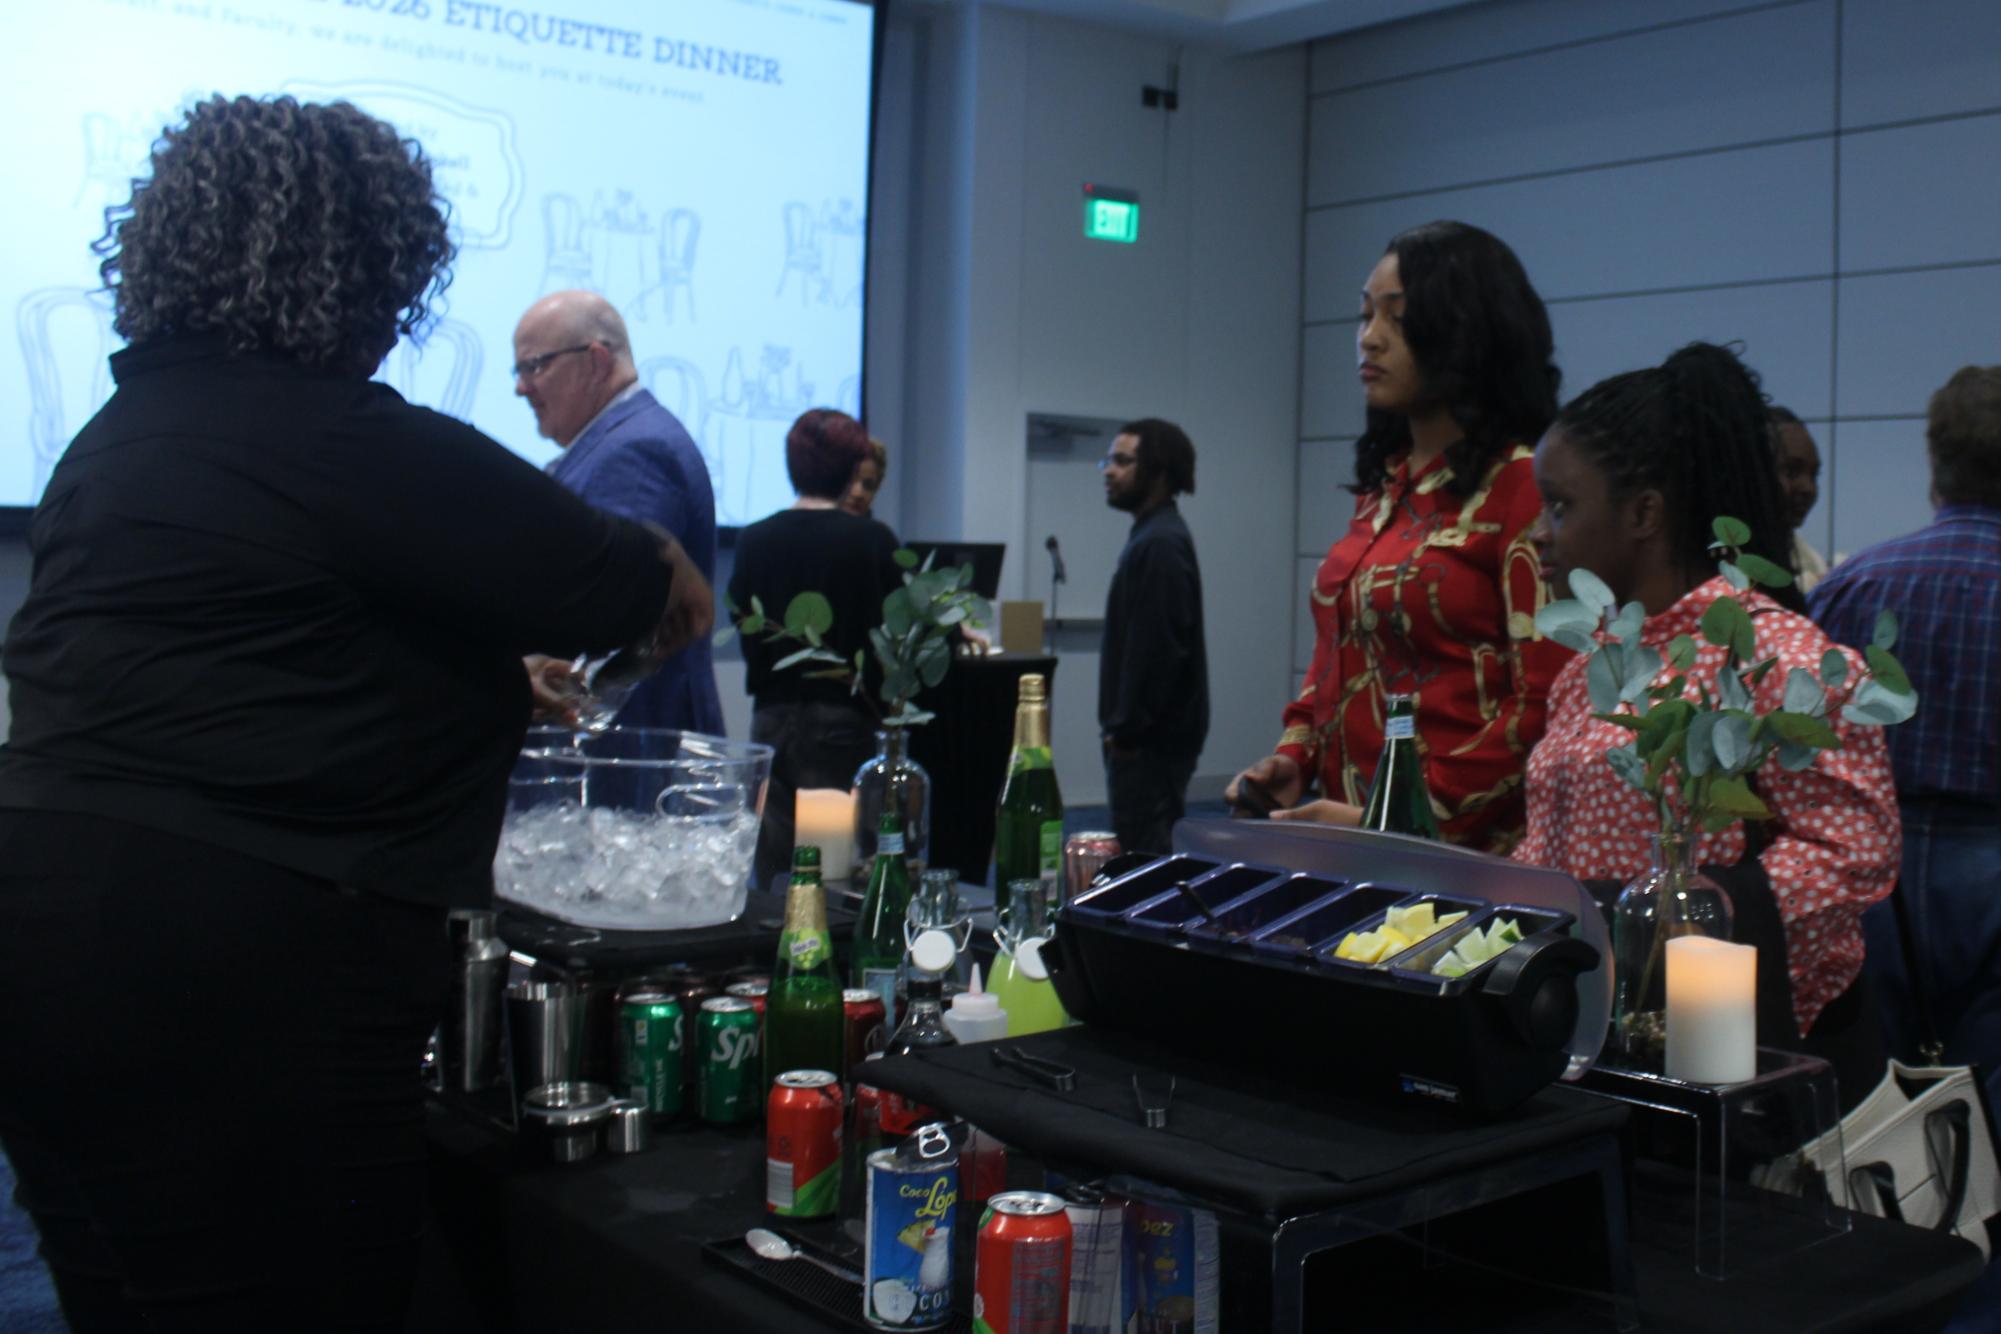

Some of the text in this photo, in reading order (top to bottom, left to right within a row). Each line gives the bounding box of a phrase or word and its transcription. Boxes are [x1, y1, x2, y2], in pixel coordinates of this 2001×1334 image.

[342, 0, 784, 86] 26 ETIQUETTE DINNER
[899, 1176, 957, 1221] Coco Lóp
